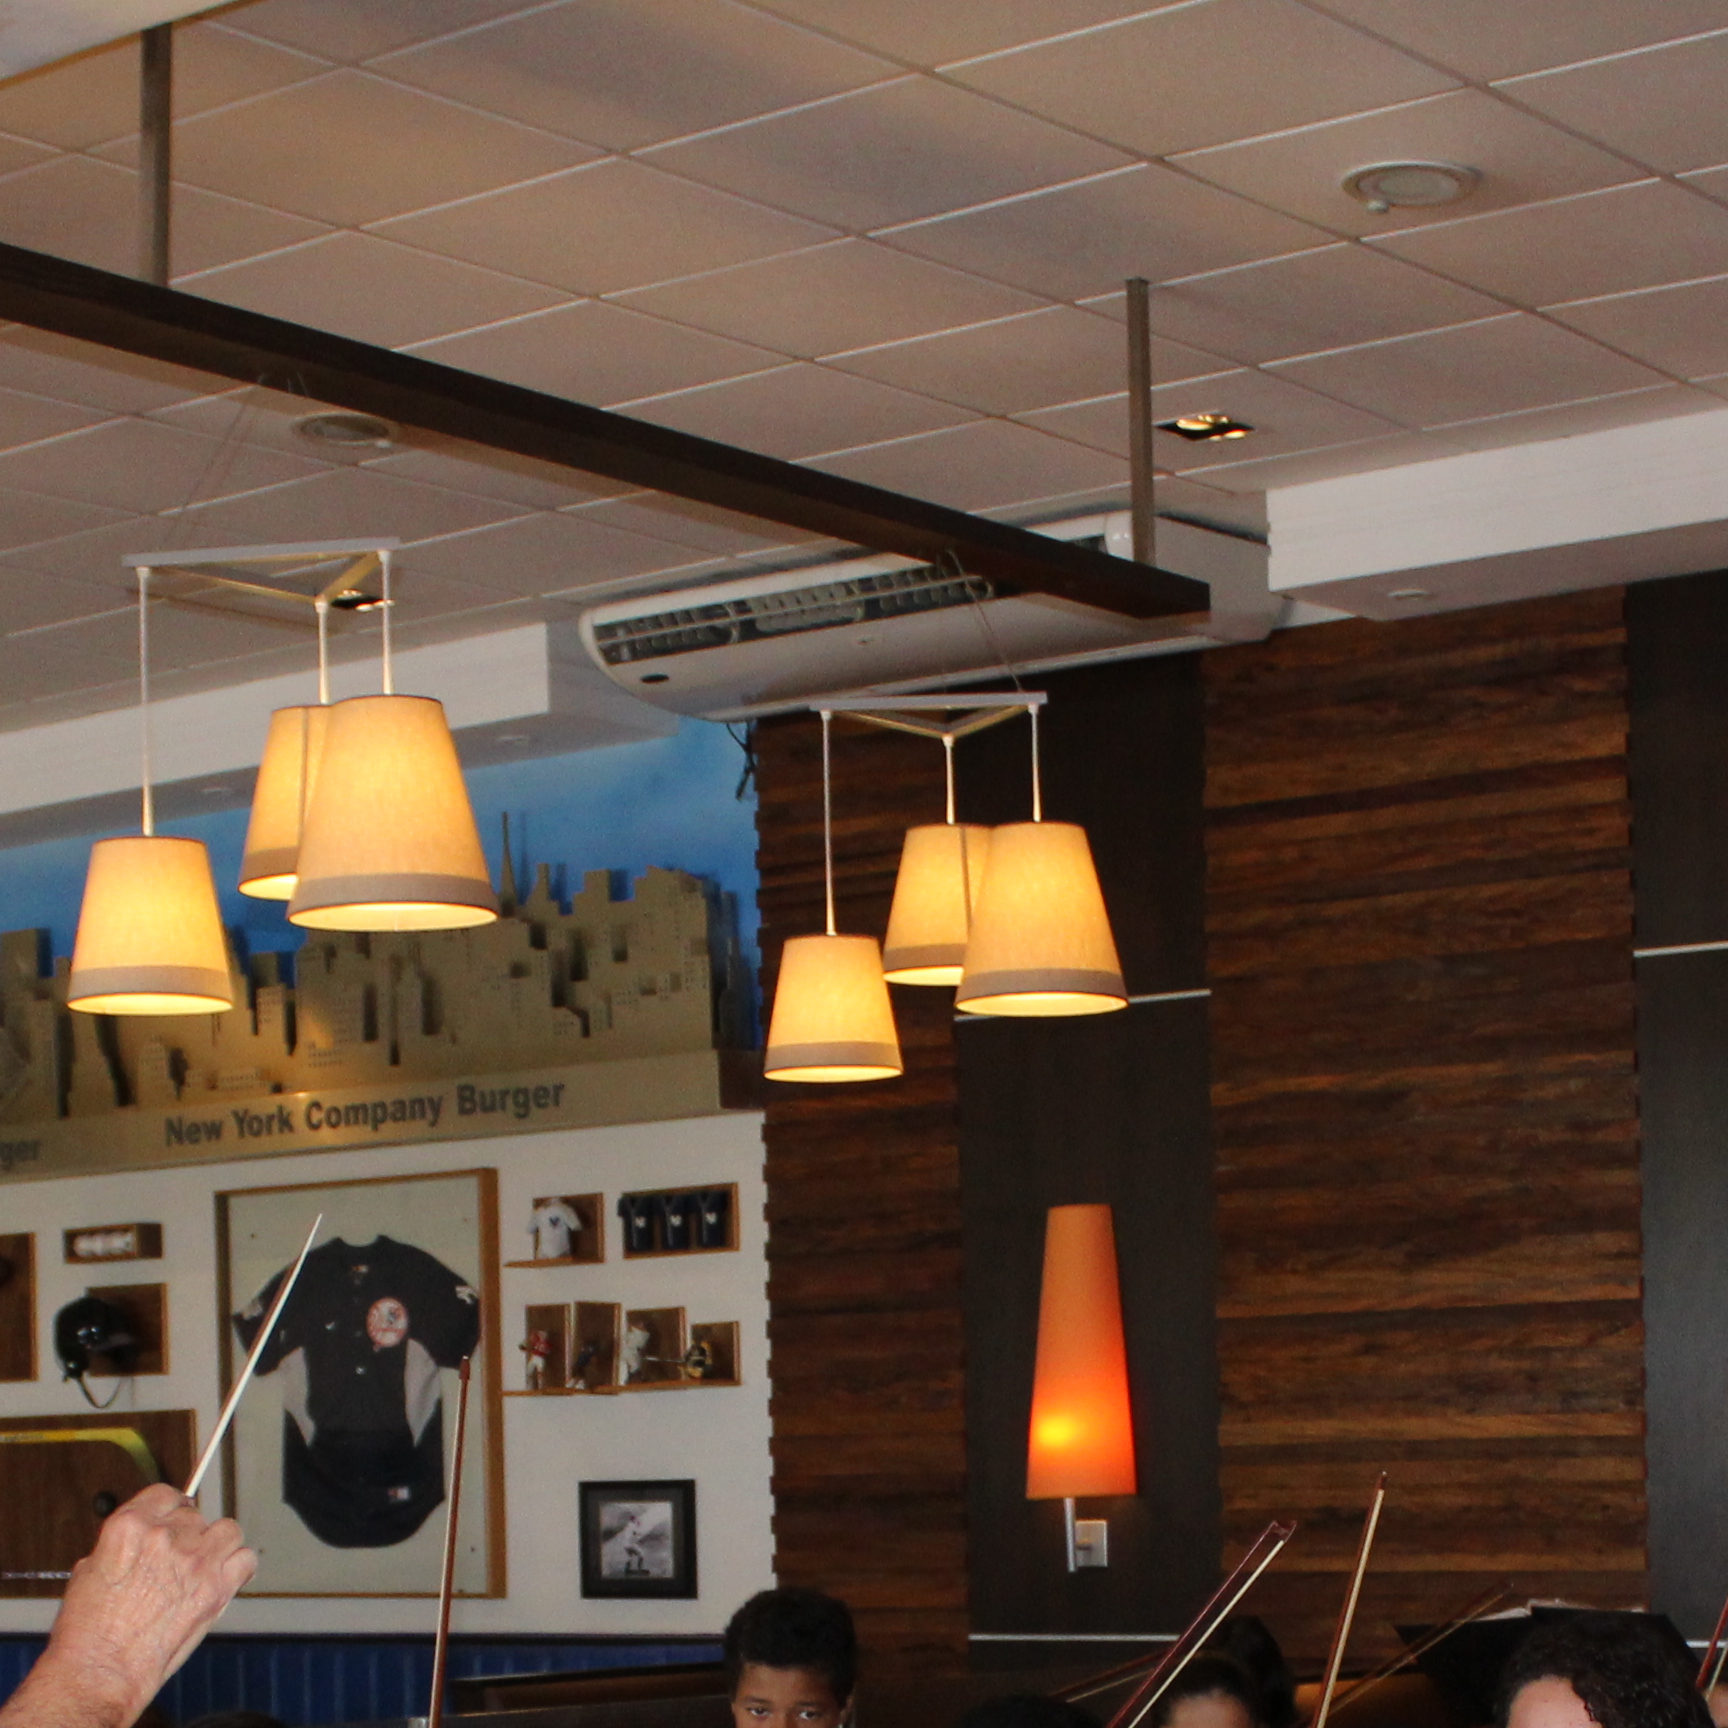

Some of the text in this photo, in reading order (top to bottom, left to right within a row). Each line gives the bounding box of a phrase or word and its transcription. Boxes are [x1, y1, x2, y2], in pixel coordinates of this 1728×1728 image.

[165, 1081, 565, 1147] New York Company Burger
